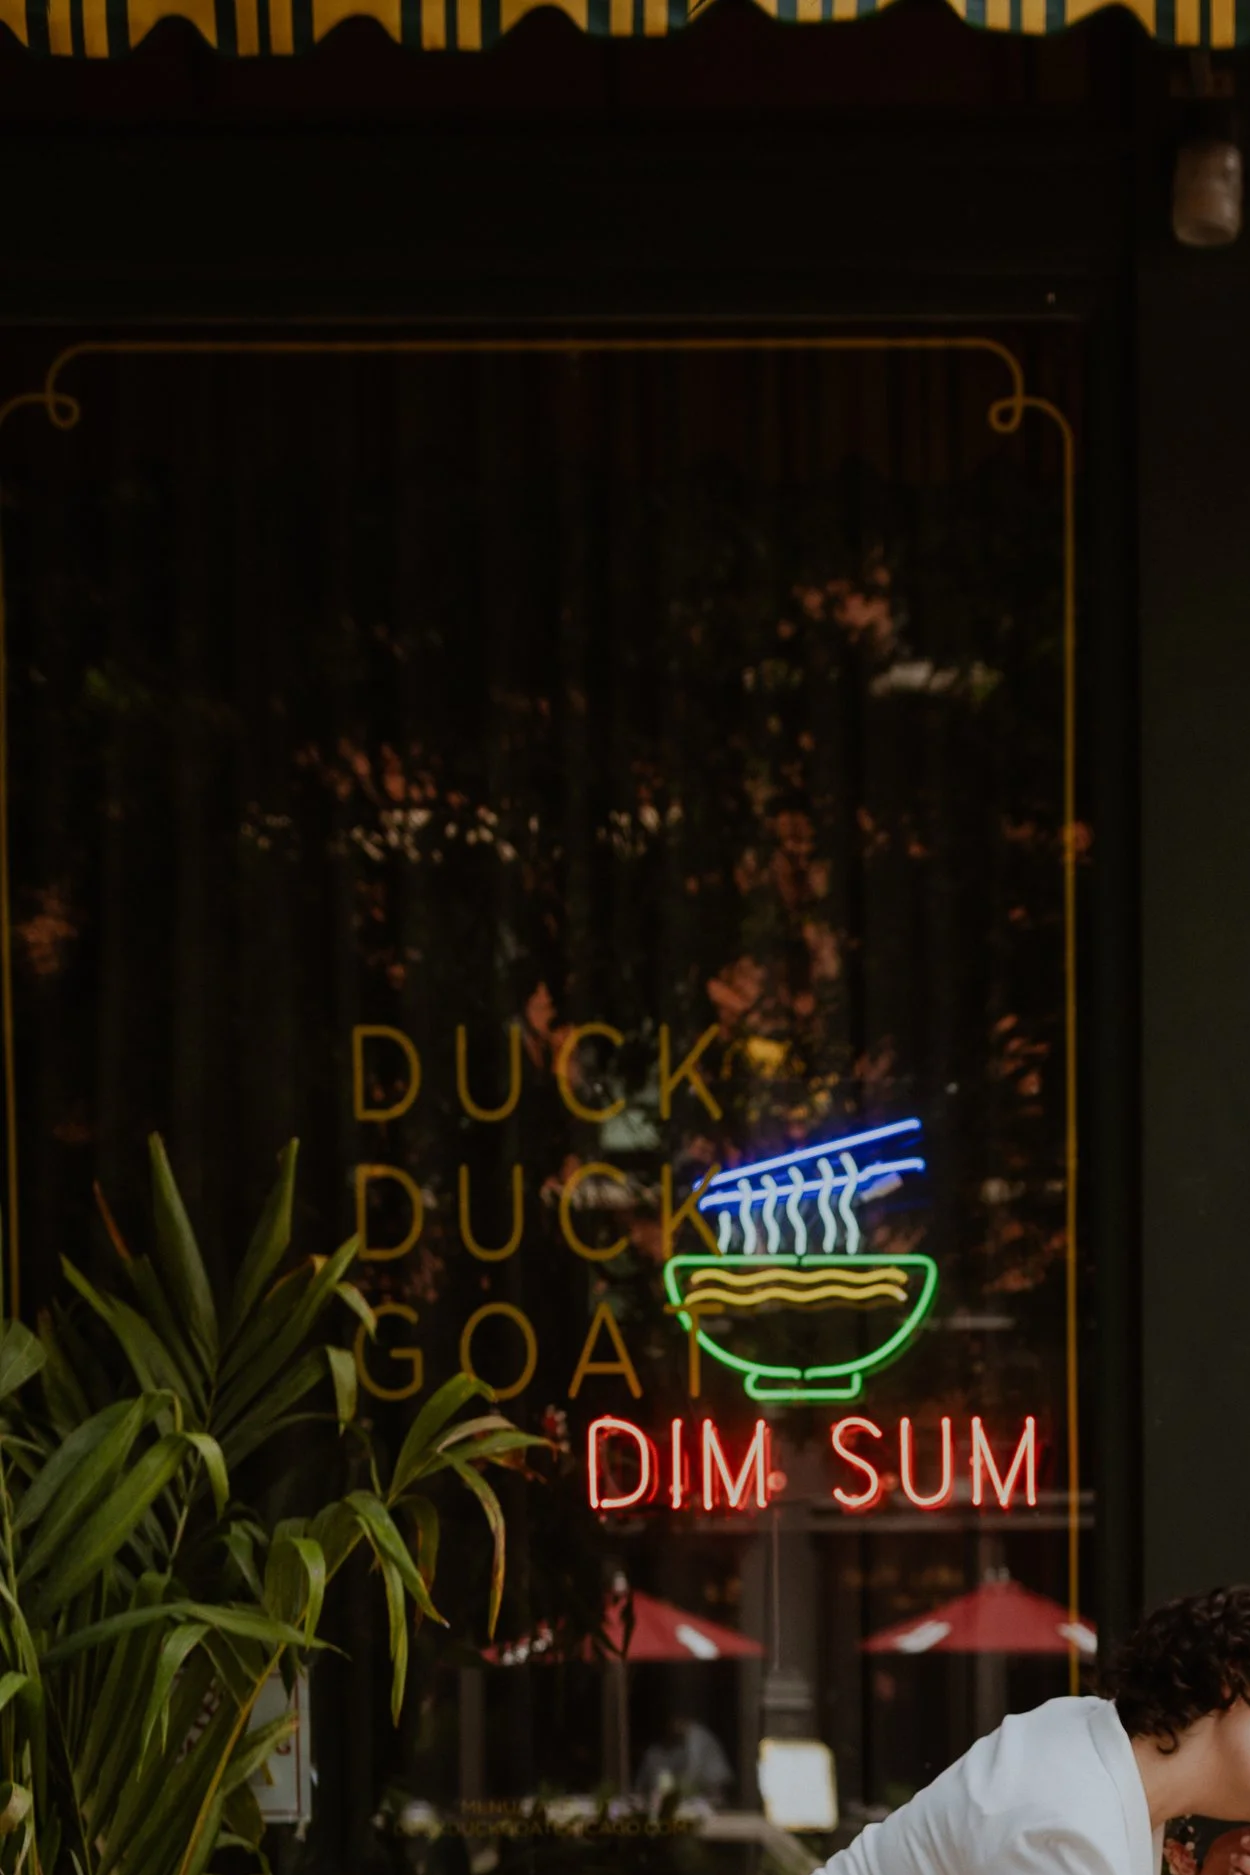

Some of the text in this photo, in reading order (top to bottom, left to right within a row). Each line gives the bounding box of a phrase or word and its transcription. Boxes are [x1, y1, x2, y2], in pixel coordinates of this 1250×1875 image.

[352, 1024, 722, 1120] DUCK
[354, 1163, 724, 1260] DUCK
[353, 1301, 723, 1400] GOAT
[588, 1415, 1038, 1510] DIM SUM
